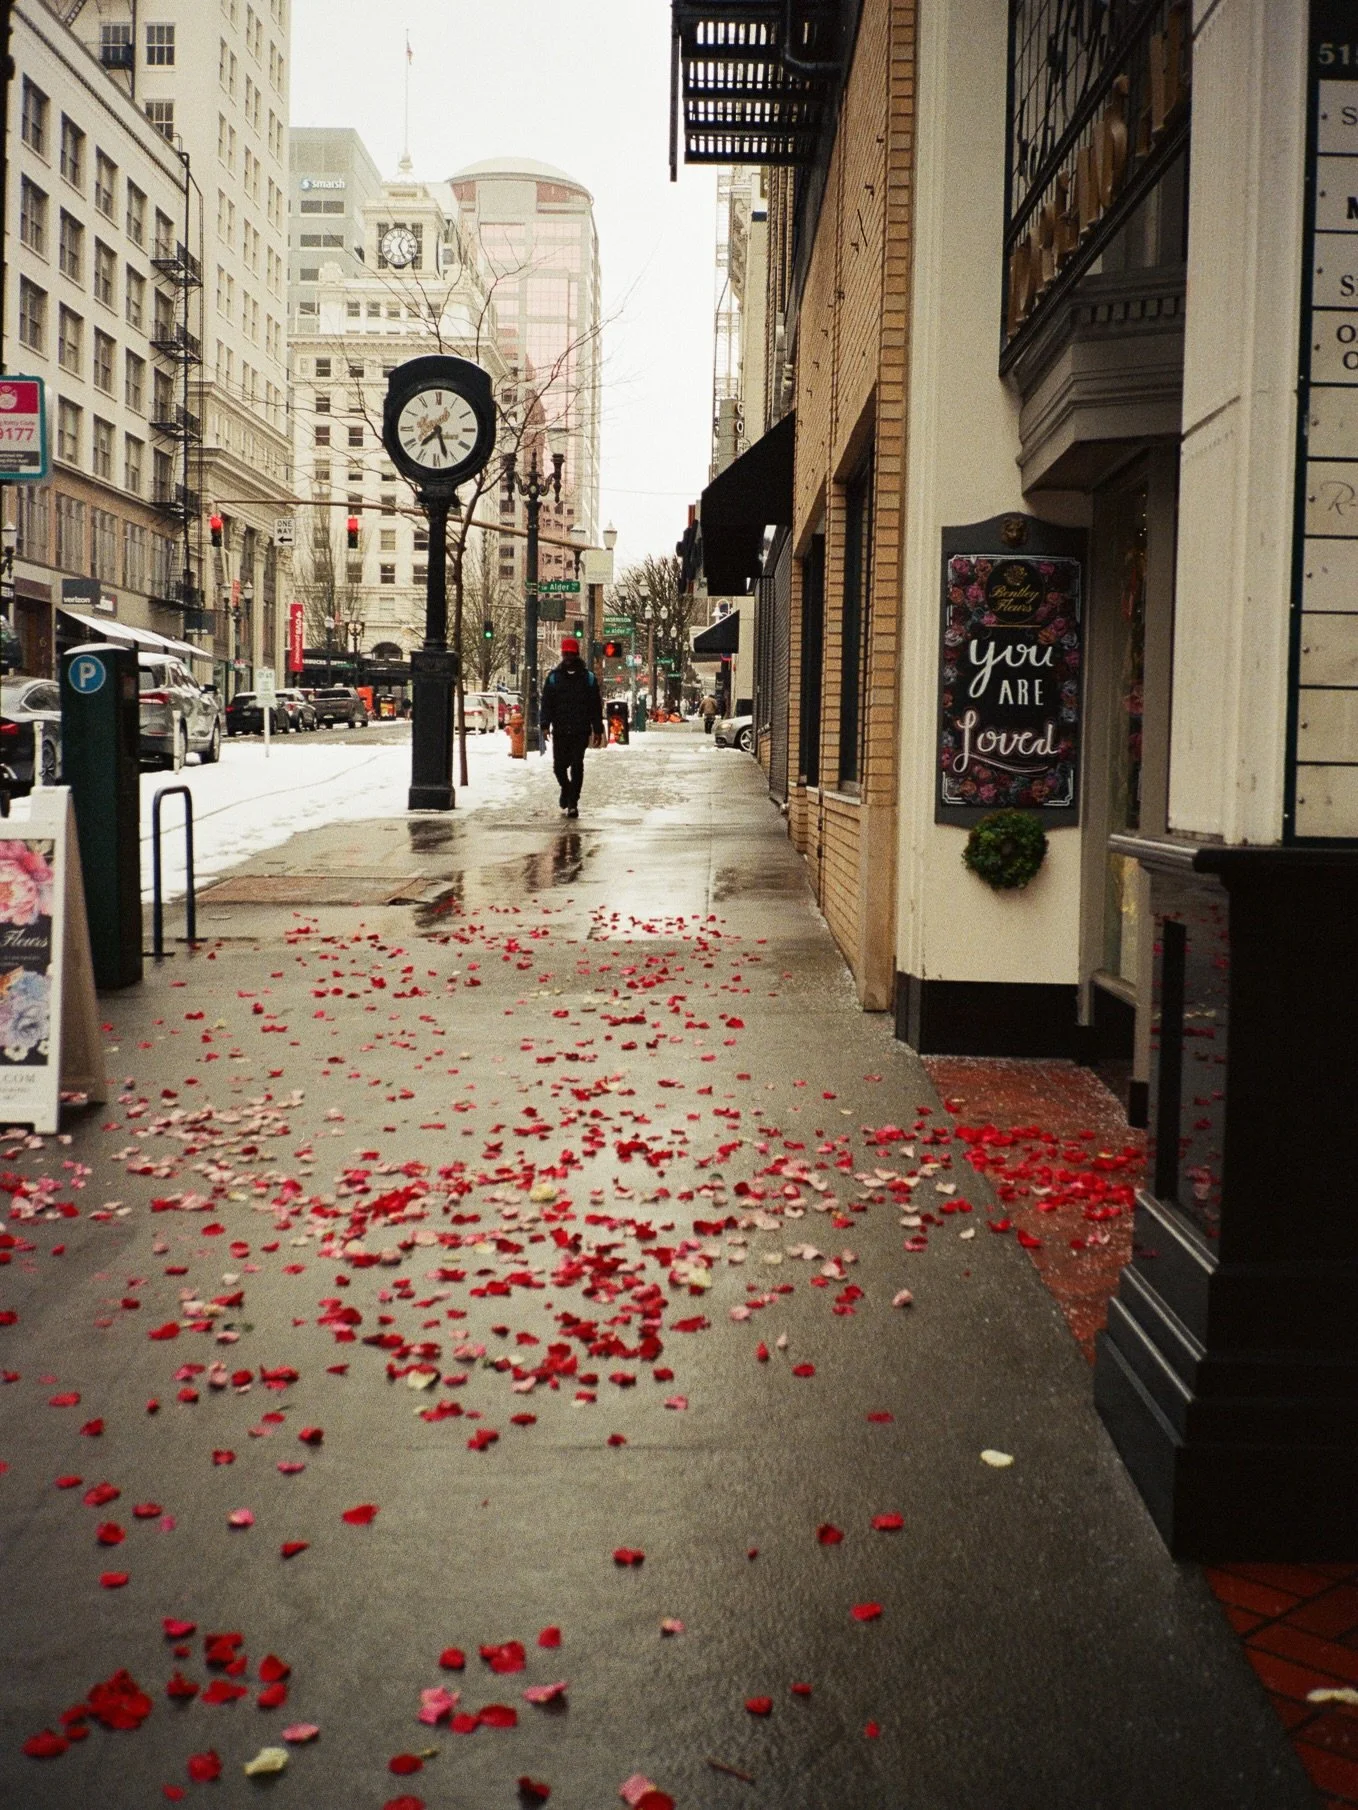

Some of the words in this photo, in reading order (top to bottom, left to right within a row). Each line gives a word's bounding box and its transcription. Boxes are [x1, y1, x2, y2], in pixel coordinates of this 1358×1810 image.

[1319, 44, 1358, 65] 51
[1342, 106, 1358, 126] S
[1340, 274, 1358, 297] S
[1336, 324, 1358, 344] O
[277, 519, 292, 527] ONE
[549, 583, 570, 592] Alder
[990, 584, 1040, 604] Bentley
[63, 596, 91, 604] verizon
[991, 598, 1033, 612] Fleurs
[998, 679, 1044, 706] ARE
[952, 709, 1060, 773] Loved
